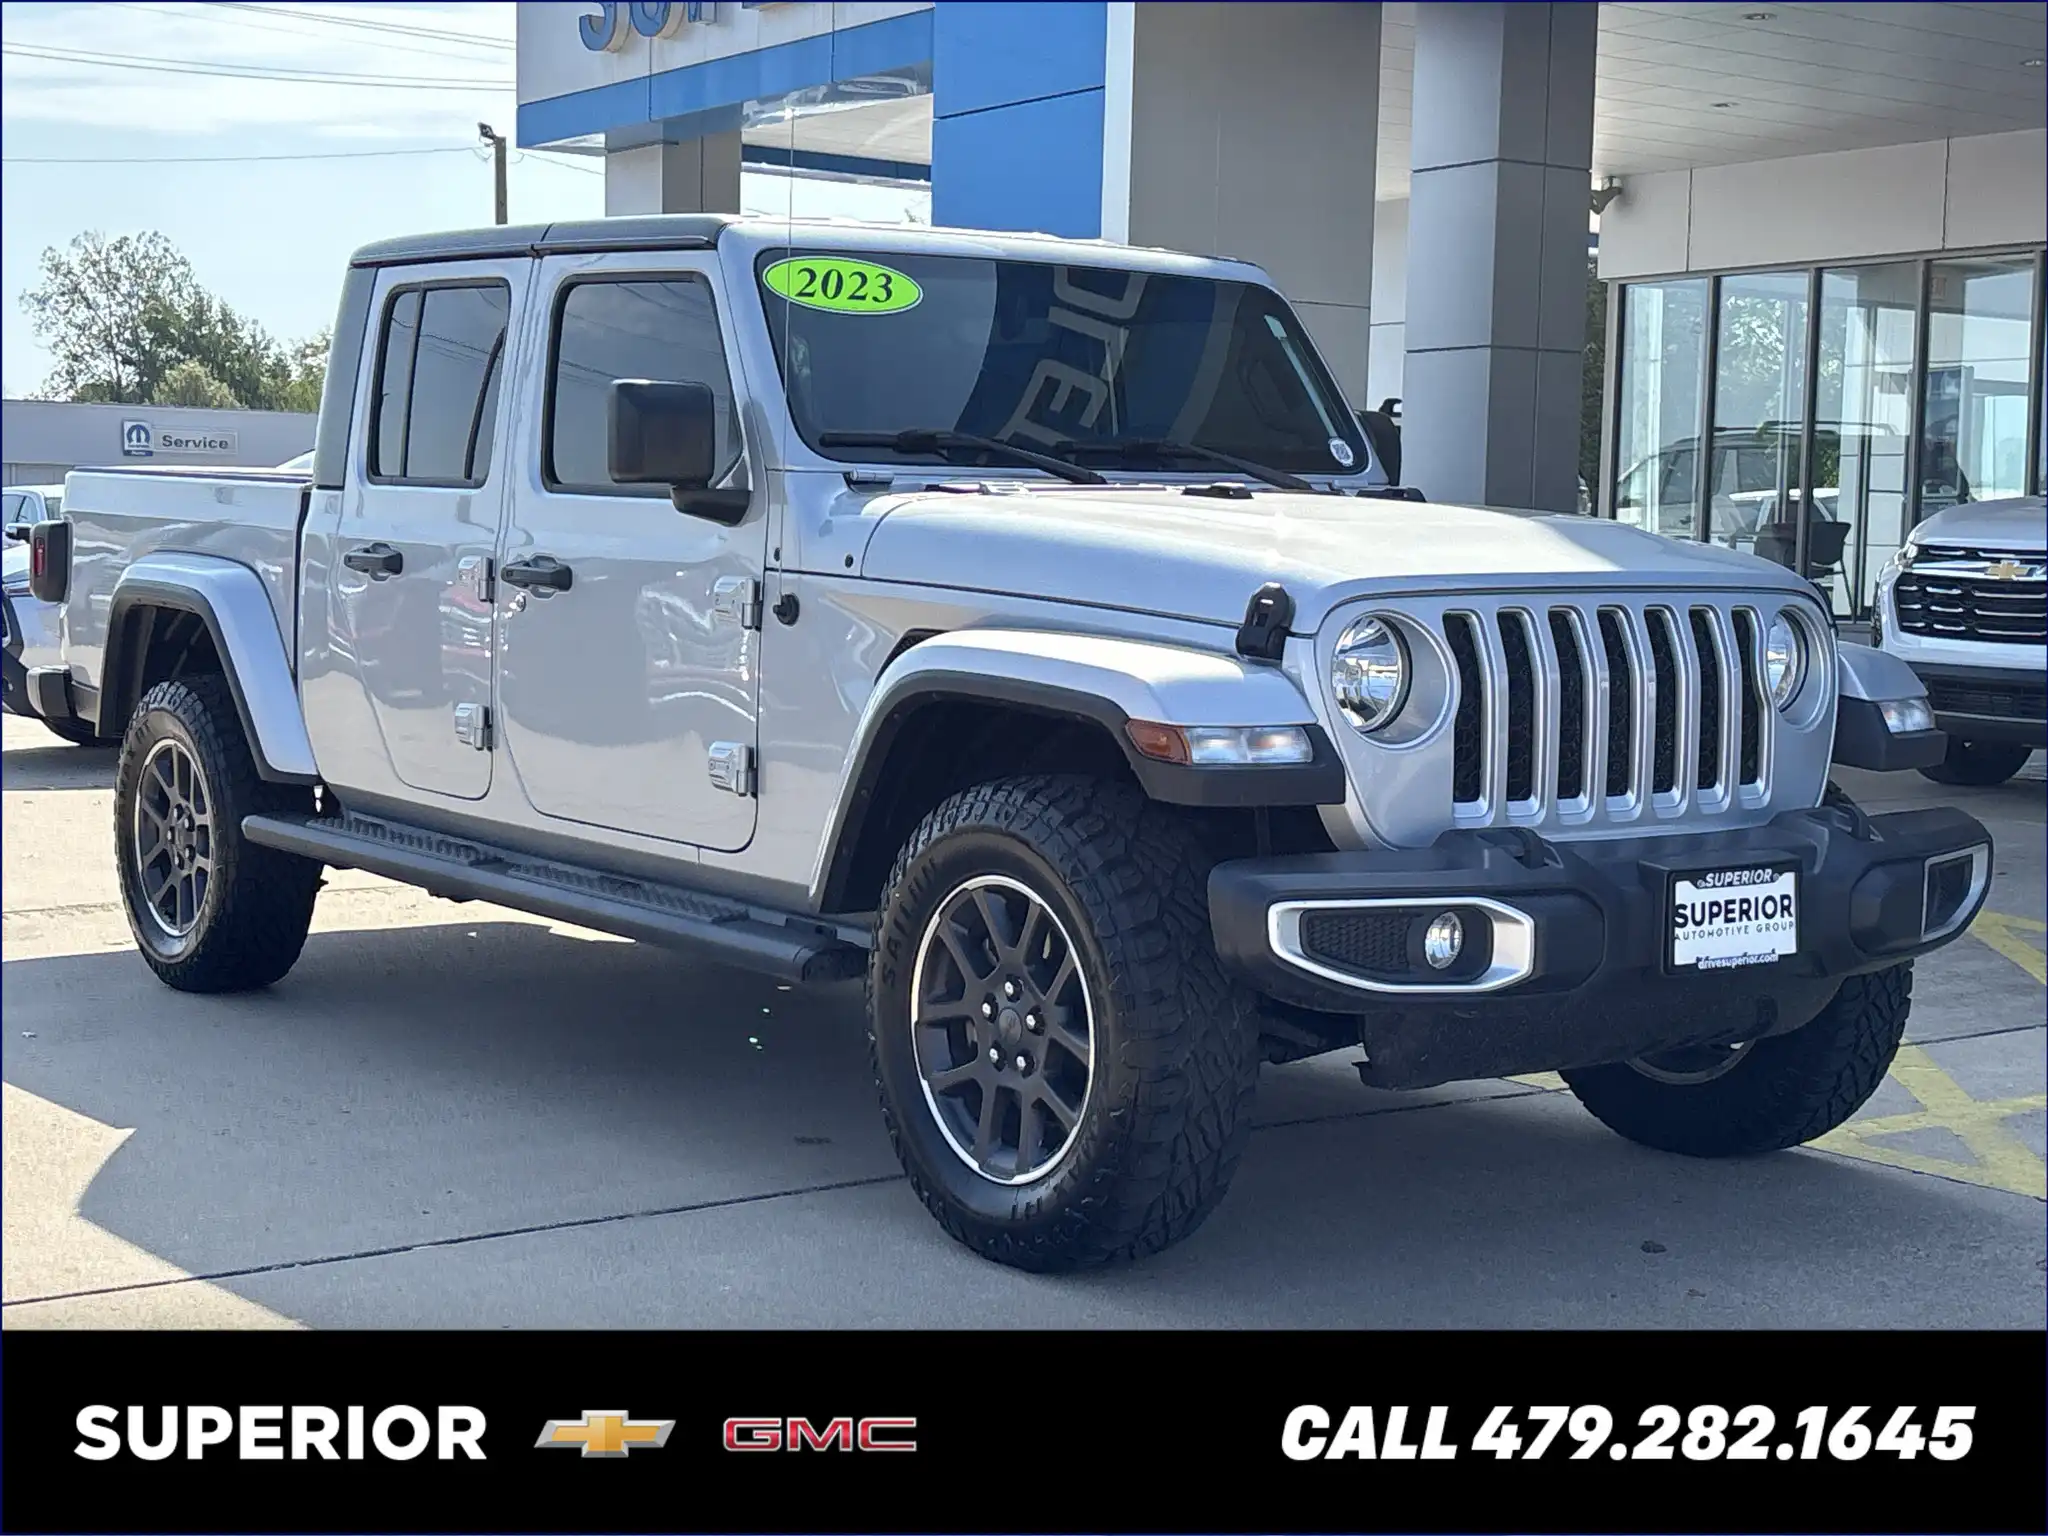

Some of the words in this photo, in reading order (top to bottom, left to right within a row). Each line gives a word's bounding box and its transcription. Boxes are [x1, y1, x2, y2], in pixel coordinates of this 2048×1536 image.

[795, 267, 893, 303] 2023
[161, 434, 229, 449] Service
[1705, 868, 1773, 888] SUPERIOR
[1674, 894, 1793, 928] SUPERIOR
[1675, 924, 1750, 941] AUTOMOTIVE
[1756, 920, 1794, 933] GROUP
[1697, 950, 1779, 970] drivesuperior.com
